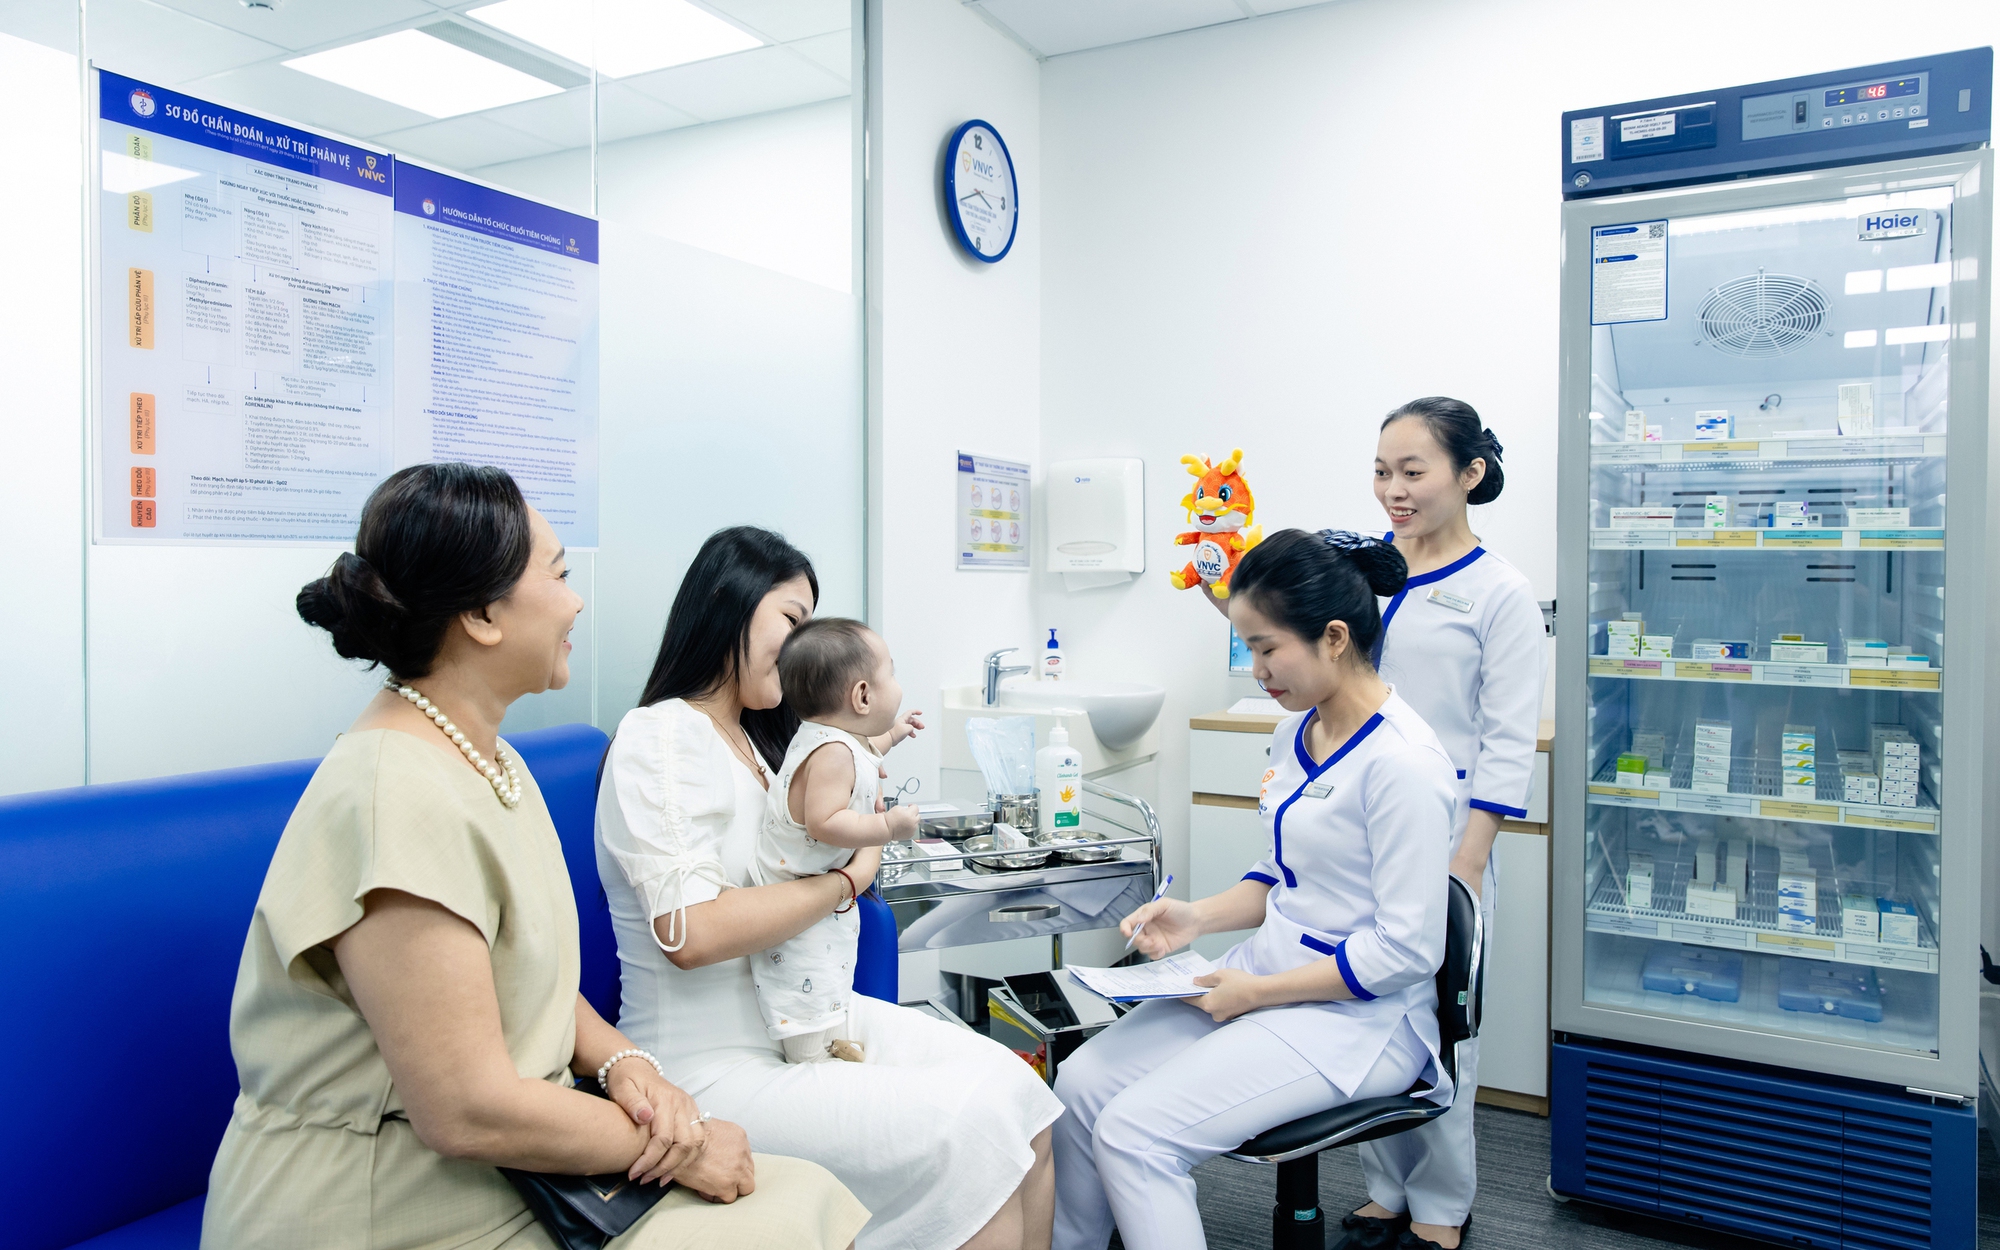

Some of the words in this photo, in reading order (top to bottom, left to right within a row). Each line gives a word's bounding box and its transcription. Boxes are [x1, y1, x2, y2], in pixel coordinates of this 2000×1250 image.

[165, 104, 180, 118] SƠ
[182, 109, 199, 124] ĐỒ
[201, 115, 231, 133] CHẨN
[234, 124, 263, 142] ĐOÁN
[276, 135, 290, 150] XỬ
[292, 141, 308, 155] TRÍ
[310, 146, 336, 164] PHẢN
[338, 154, 350, 170] VỆ
[974, 133, 982, 150] 12
[973, 158, 993, 177] VNVC
[357, 167, 385, 183] VNVC
[1000, 196, 1006, 210] 3
[442, 204, 467, 219] HƯỚNG
[468, 211, 482, 224] DẪN
[483, 215, 491, 226] TỔ
[492, 218, 509, 231] CHỨC
[510, 223, 525, 235] BUỔI
[526, 227, 539, 239] TIÊM
[540, 231, 560, 245] CHỦNG
[1866, 214, 1918, 230] Haier
[565, 244, 579, 253] VNVC
[976, 236, 982, 250] 6
[134, 312, 142, 325] CẤP
[134, 337, 142, 346] XỬ
[136, 440, 142, 450] XỬ
[1197, 560, 1220, 571] VNVC
